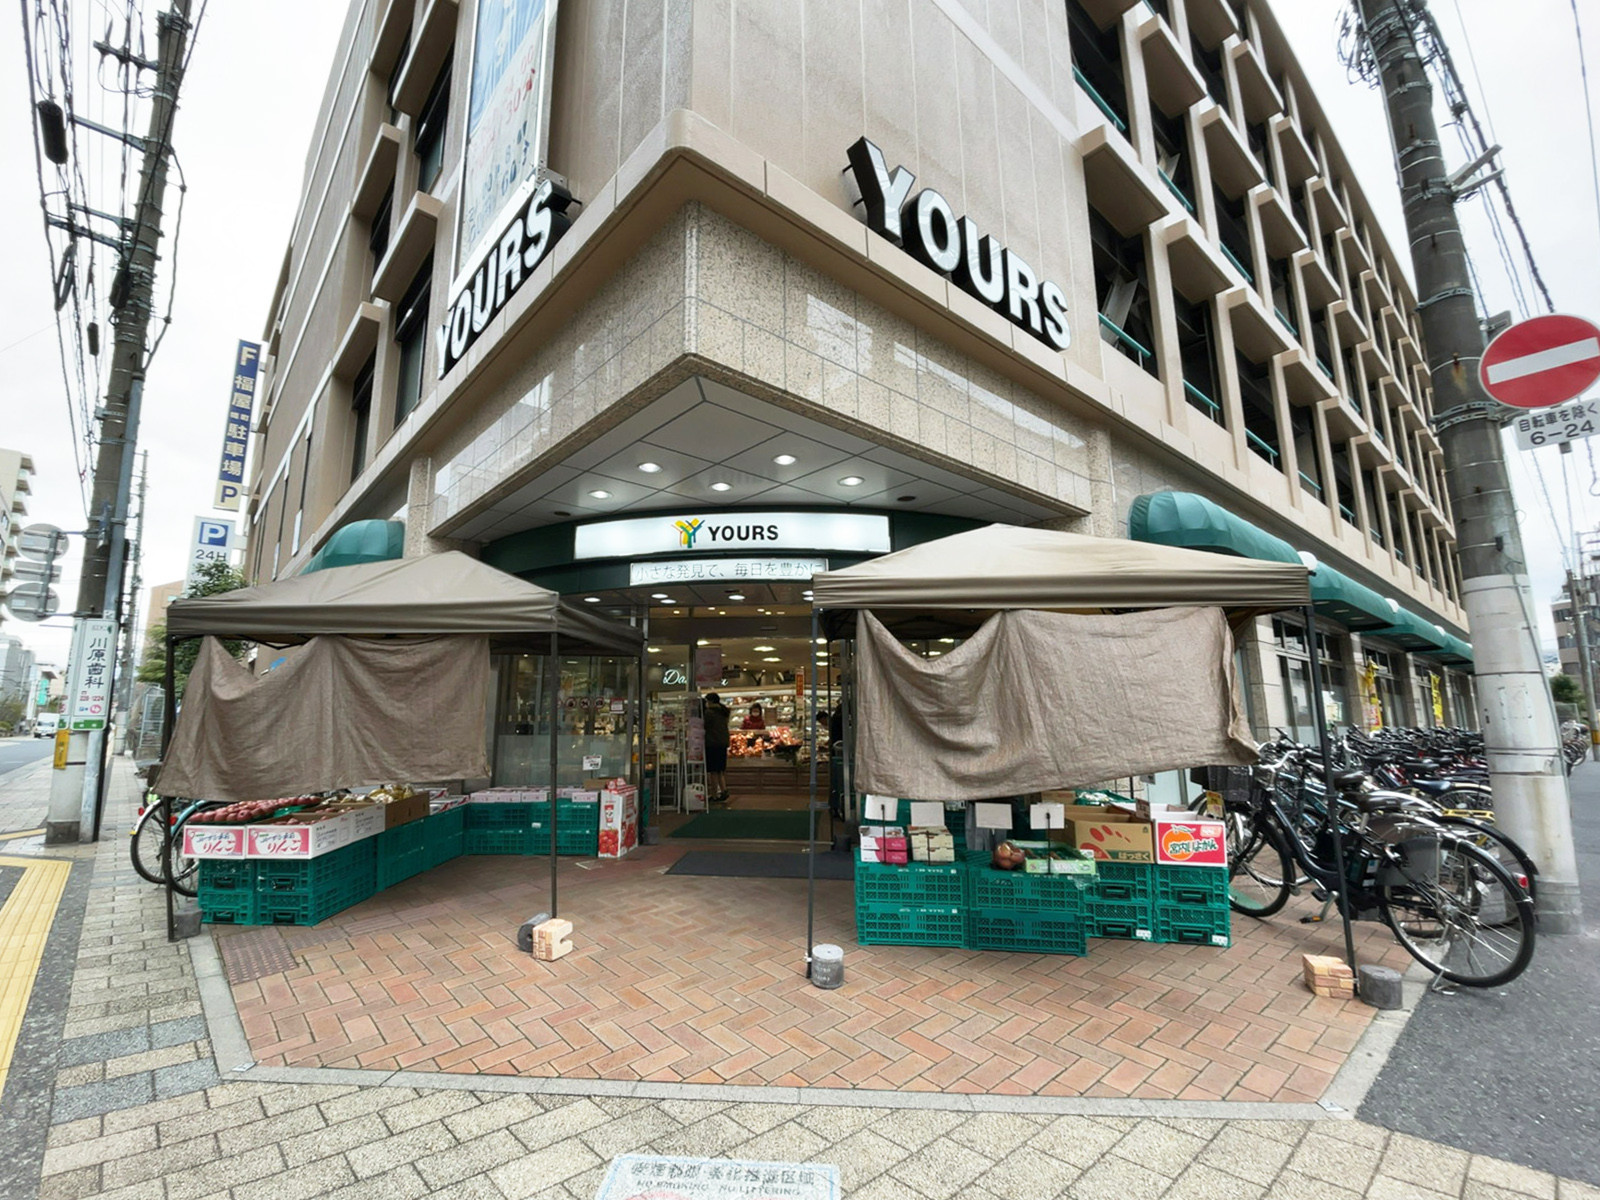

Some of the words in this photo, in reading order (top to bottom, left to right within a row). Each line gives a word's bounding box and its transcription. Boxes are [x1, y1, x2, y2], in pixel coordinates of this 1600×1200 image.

[856, 136, 1071, 350] YOURS
[436, 179, 553, 380] YOURS
[240, 346, 258, 366] F
[1518, 403, 1599, 432] 自転車を除く
[220, 485, 238, 503] P
[202, 523, 227, 544] P
[708, 525, 779, 541] YOURS
[196, 549, 227, 562] 24H
[85, 637, 107, 689] 川原歯科
[203, 840, 236, 854] りんご
[267, 840, 301, 854] りんご
